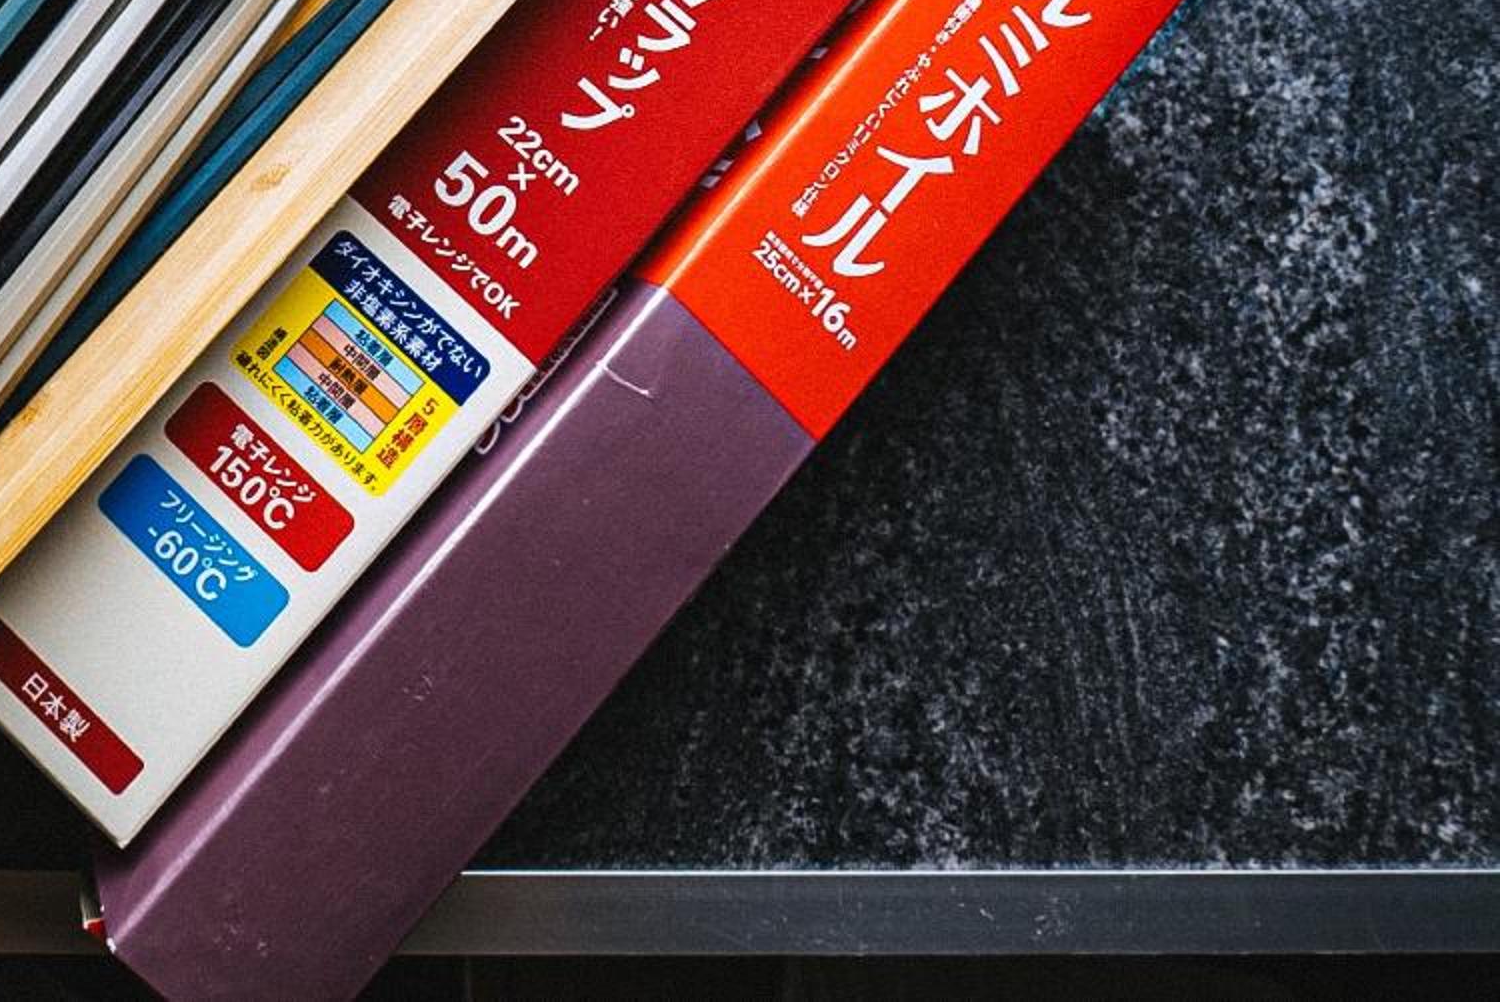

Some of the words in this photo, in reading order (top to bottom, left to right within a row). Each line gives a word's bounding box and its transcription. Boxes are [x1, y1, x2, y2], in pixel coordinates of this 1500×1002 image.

[498, 116, 579, 195] 22cm
[435, 151, 537, 268] 50m
[388, 195, 520, 319] 電子レンジでOK
[336, 242, 482, 378] ダイオキシンがでない
[345, 280, 442, 371] 非塩素系素材
[231, 424, 316, 502] 電子レンジ
[161, 491, 258, 581] フリージング
[22, 673, 90, 742] 日本製
